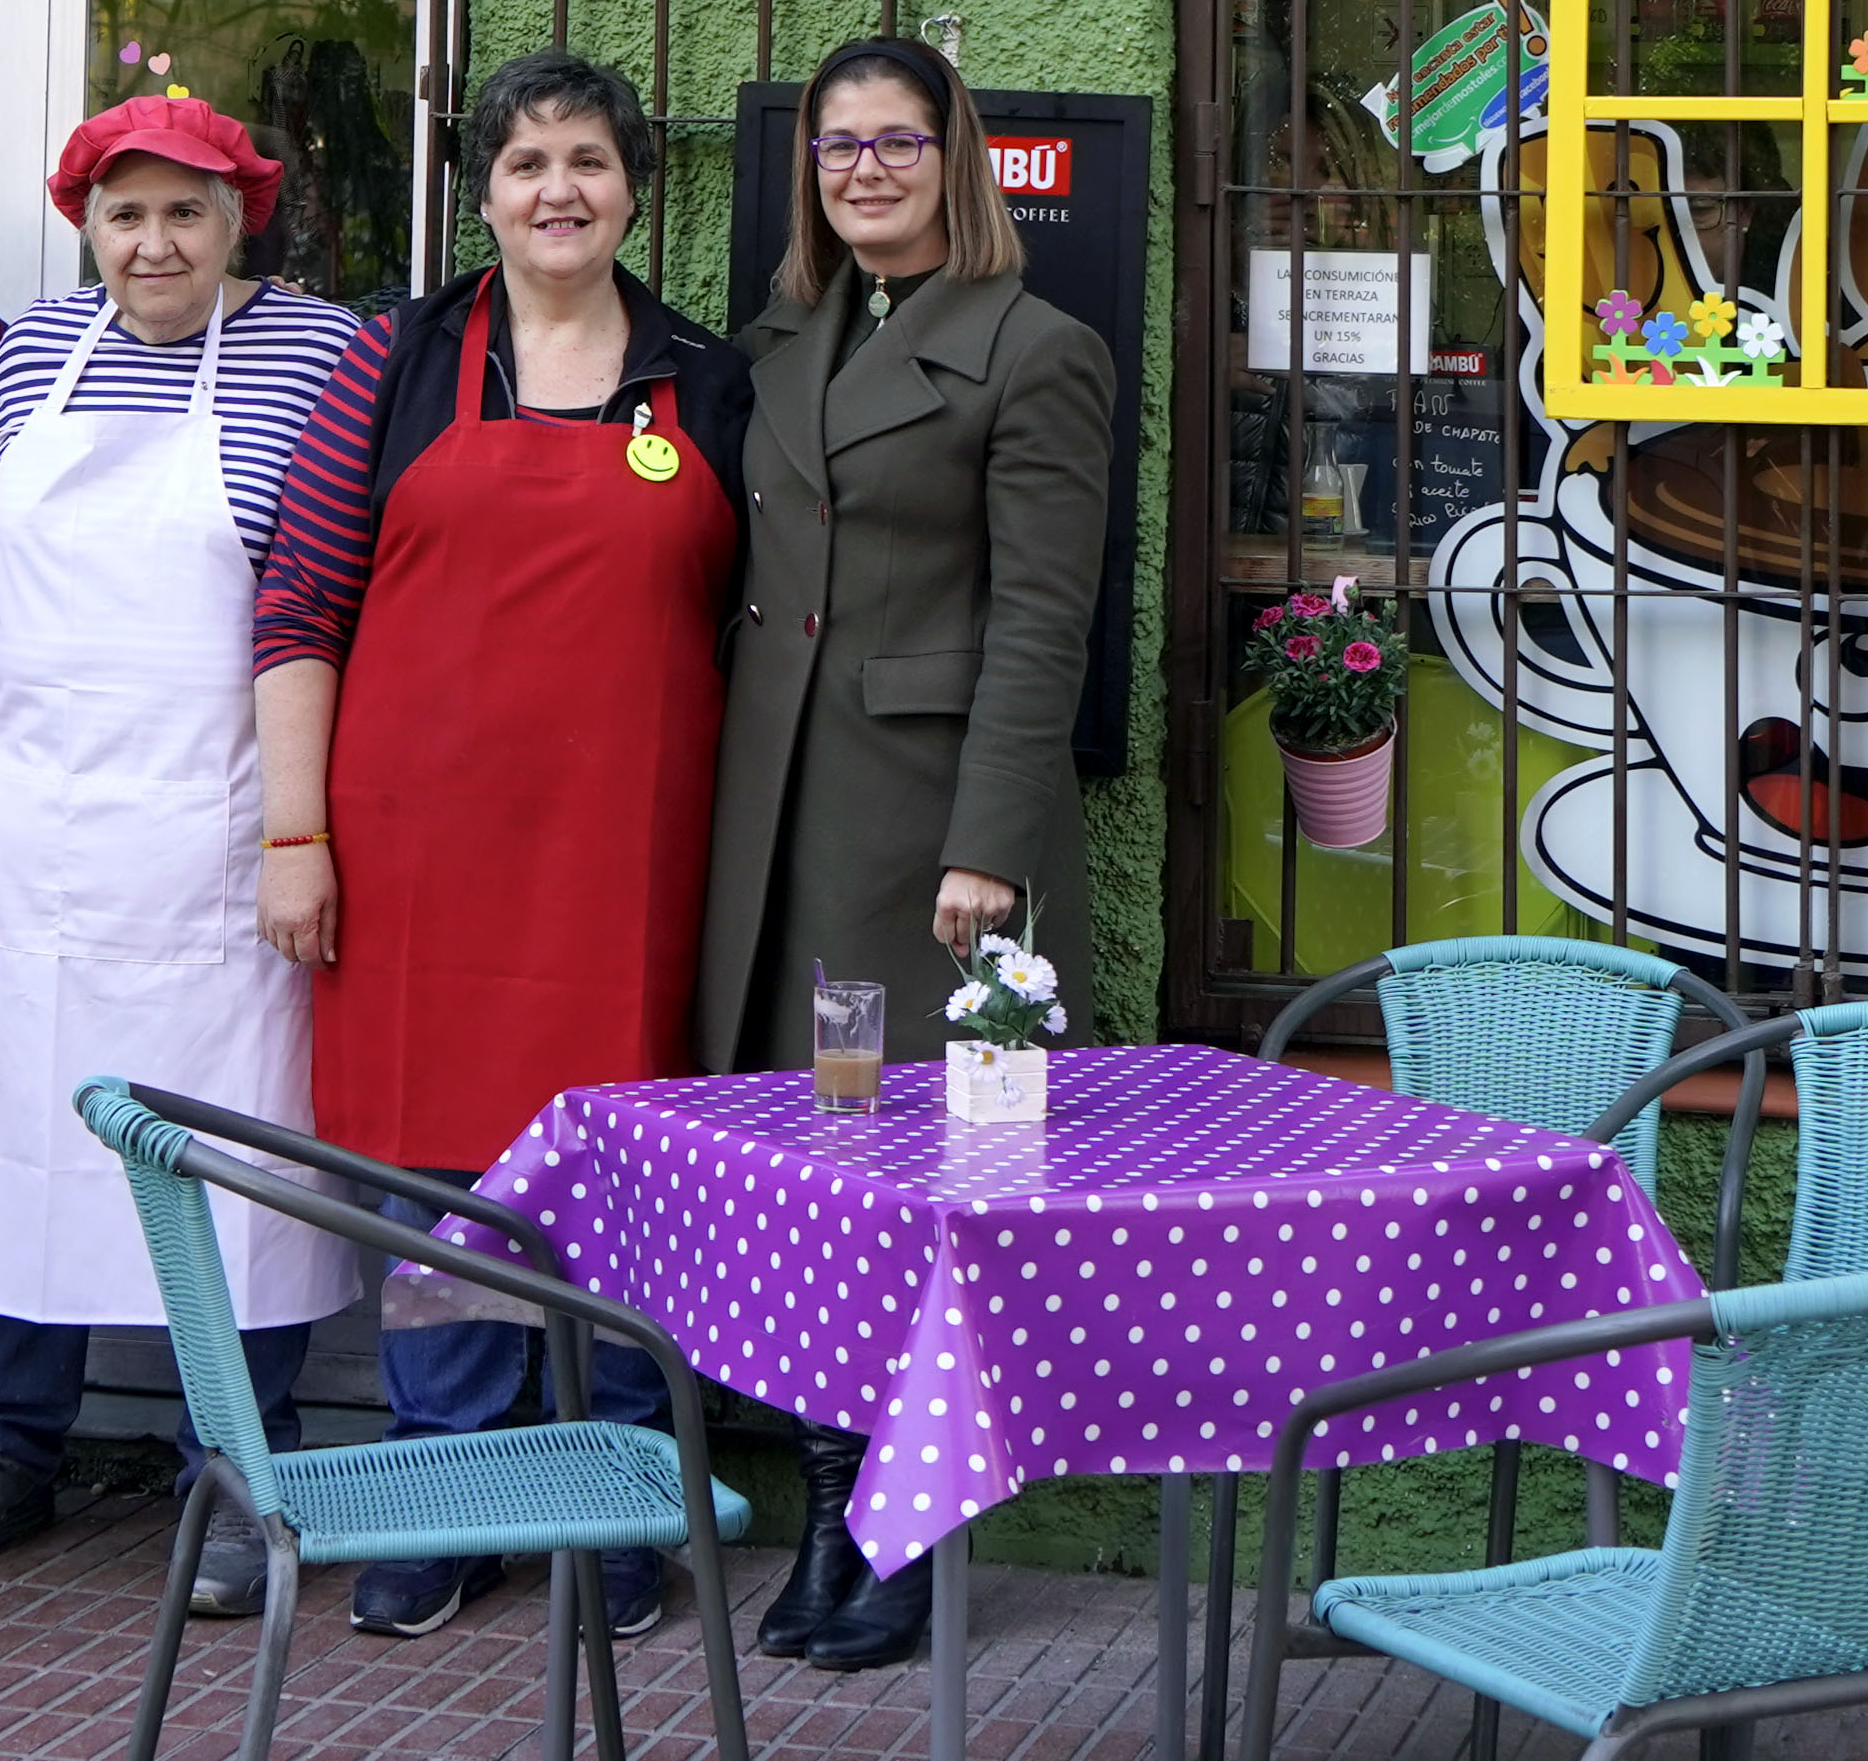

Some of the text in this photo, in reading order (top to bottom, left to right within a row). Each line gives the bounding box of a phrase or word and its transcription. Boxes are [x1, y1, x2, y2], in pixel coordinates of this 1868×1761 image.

[1413, 11, 1496, 83] encanta estar
[1474, 36, 1500, 64] por
[1006, 206, 1070, 223] OFFEE
[1305, 289, 1379, 301] EN TERRAZA
[1314, 331, 1361, 342] UN 15%
[1312, 351, 1365, 364] GRACIAS
[1413, 420, 1432, 434] DE
[1430, 453, 1483, 477] tomate
[1421, 479, 1470, 498] aceite
